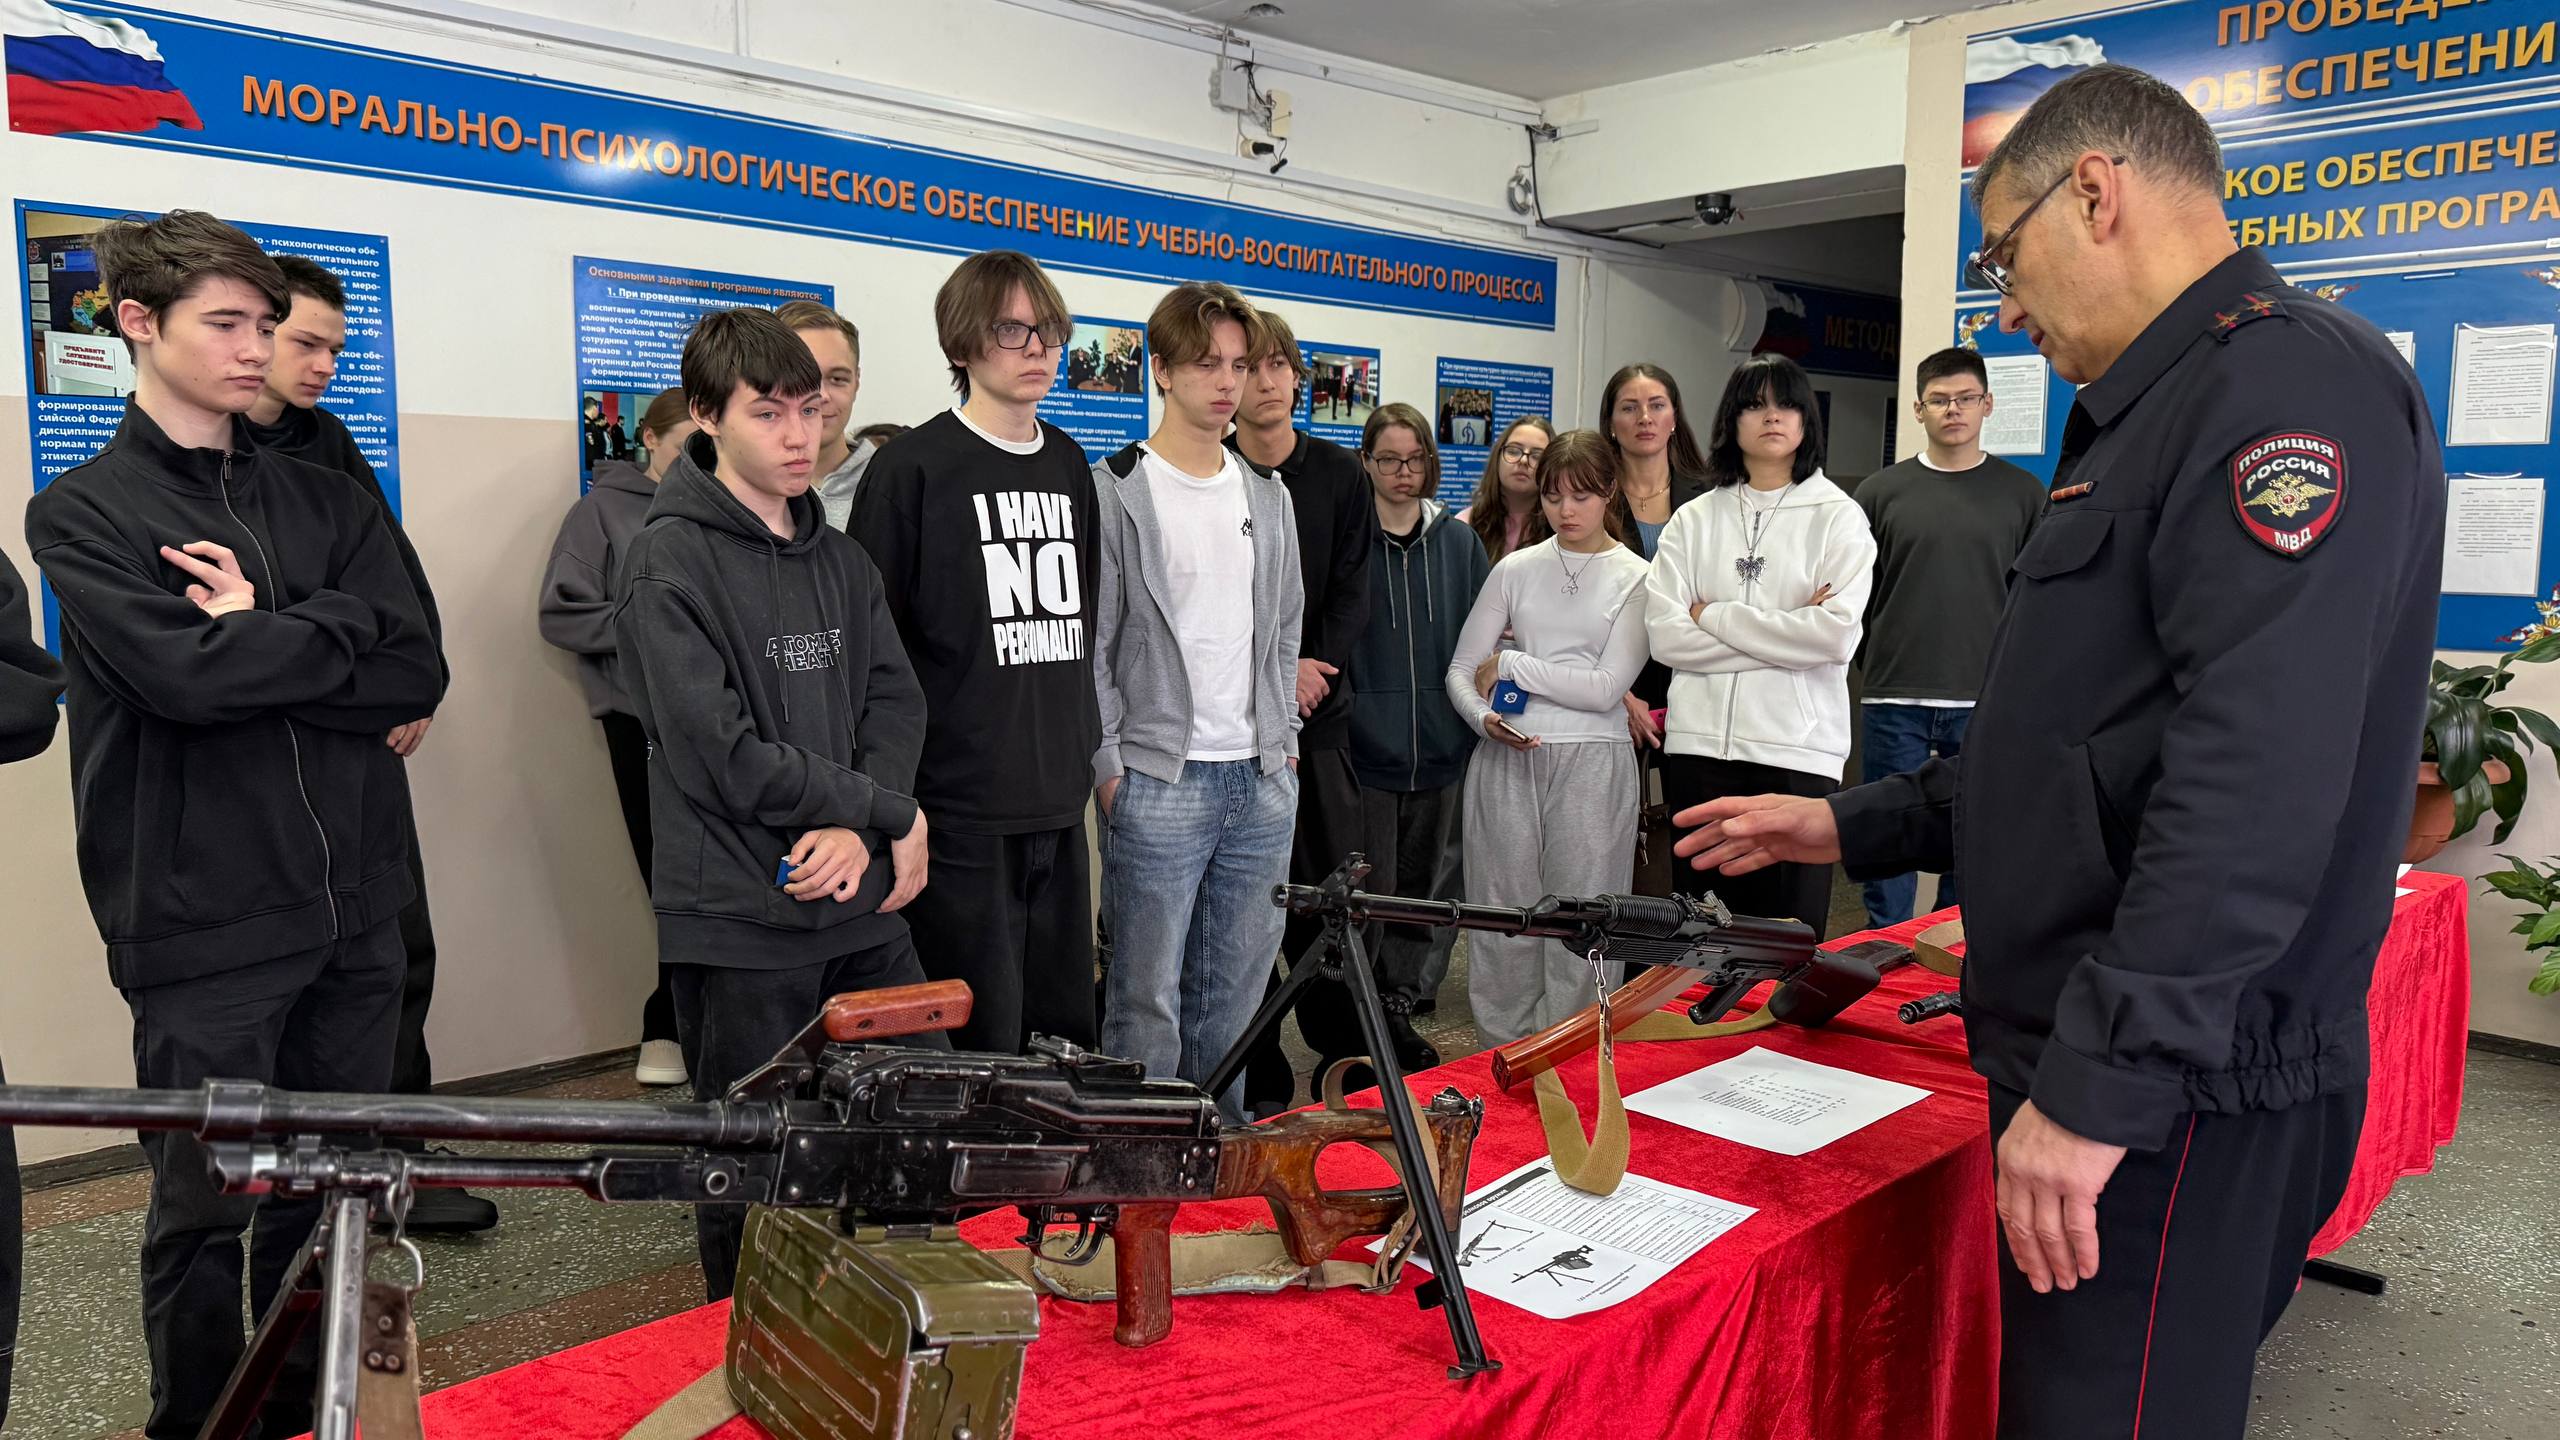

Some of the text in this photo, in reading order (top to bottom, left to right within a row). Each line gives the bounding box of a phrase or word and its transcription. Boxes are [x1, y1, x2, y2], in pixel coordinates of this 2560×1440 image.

[2217, 0, 2503, 47] ПРОВЕД
[2316, 130, 2560, 188] ОБЕСПЕЧЕ
[241, 75, 1544, 305] МОРАЛЬНО-ПСИХОЛОГИЧЕСКОЕ ОБЕСПЕЧЕНИЕ УЧЕБНО-ВОСПИТАТЕЛЬНОГО ПРОЦЕССА
[271, 238, 356, 254] психологическое
[358, 247, 379, 256] обе-
[351, 270, 380, 279] систе-
[352, 282, 381, 291] меро-
[589, 265, 823, 301] Основными задачами программы являются:
[607, 287, 616, 296] 1.
[619, 288, 639, 299] При
[640, 290, 698, 305] проведении
[368, 306, 382, 314] за-
[589, 304, 636, 315] воспитание
[640, 308, 686, 320] слушателей
[580, 314, 624, 325] уклонного
[624, 317, 673, 329] соблюдения
[362, 328, 383, 338] обу-
[609, 326, 655, 337] Российской
[581, 335, 628, 346] сотрудника
[634, 339, 667, 349] органов
[1823, 315, 1896, 361] МЕТОД
[338, 351, 384, 360] ское обе-
[582, 346, 621, 356] приказов
[360, 363, 384, 371] соот-
[582, 357, 630, 368] внутренних
[591, 367, 652, 378] формирование
[341, 374, 385, 384] програм-
[583, 378, 632, 388] сиональных
[633, 381, 661, 389] знаний
[332, 386, 385, 395] последова-
[37, 399, 126, 412] формирование
[38, 413, 86, 423] сийской
[347, 414, 365, 422] дел
[366, 413, 386, 422] Рос-
[39, 427, 117, 438] дисциплинир
[40, 440, 86, 450] нормам
[40, 452, 86, 461] этикета
[2238, 438, 2335, 473] ПОЛИЦИЯ
[367, 459, 388, 468] оды
[2245, 456, 2331, 493] РОССИЯ
[972, 493, 993, 542] I
[2273, 526, 2313, 551] МВД
[981, 541, 1082, 619] NO
